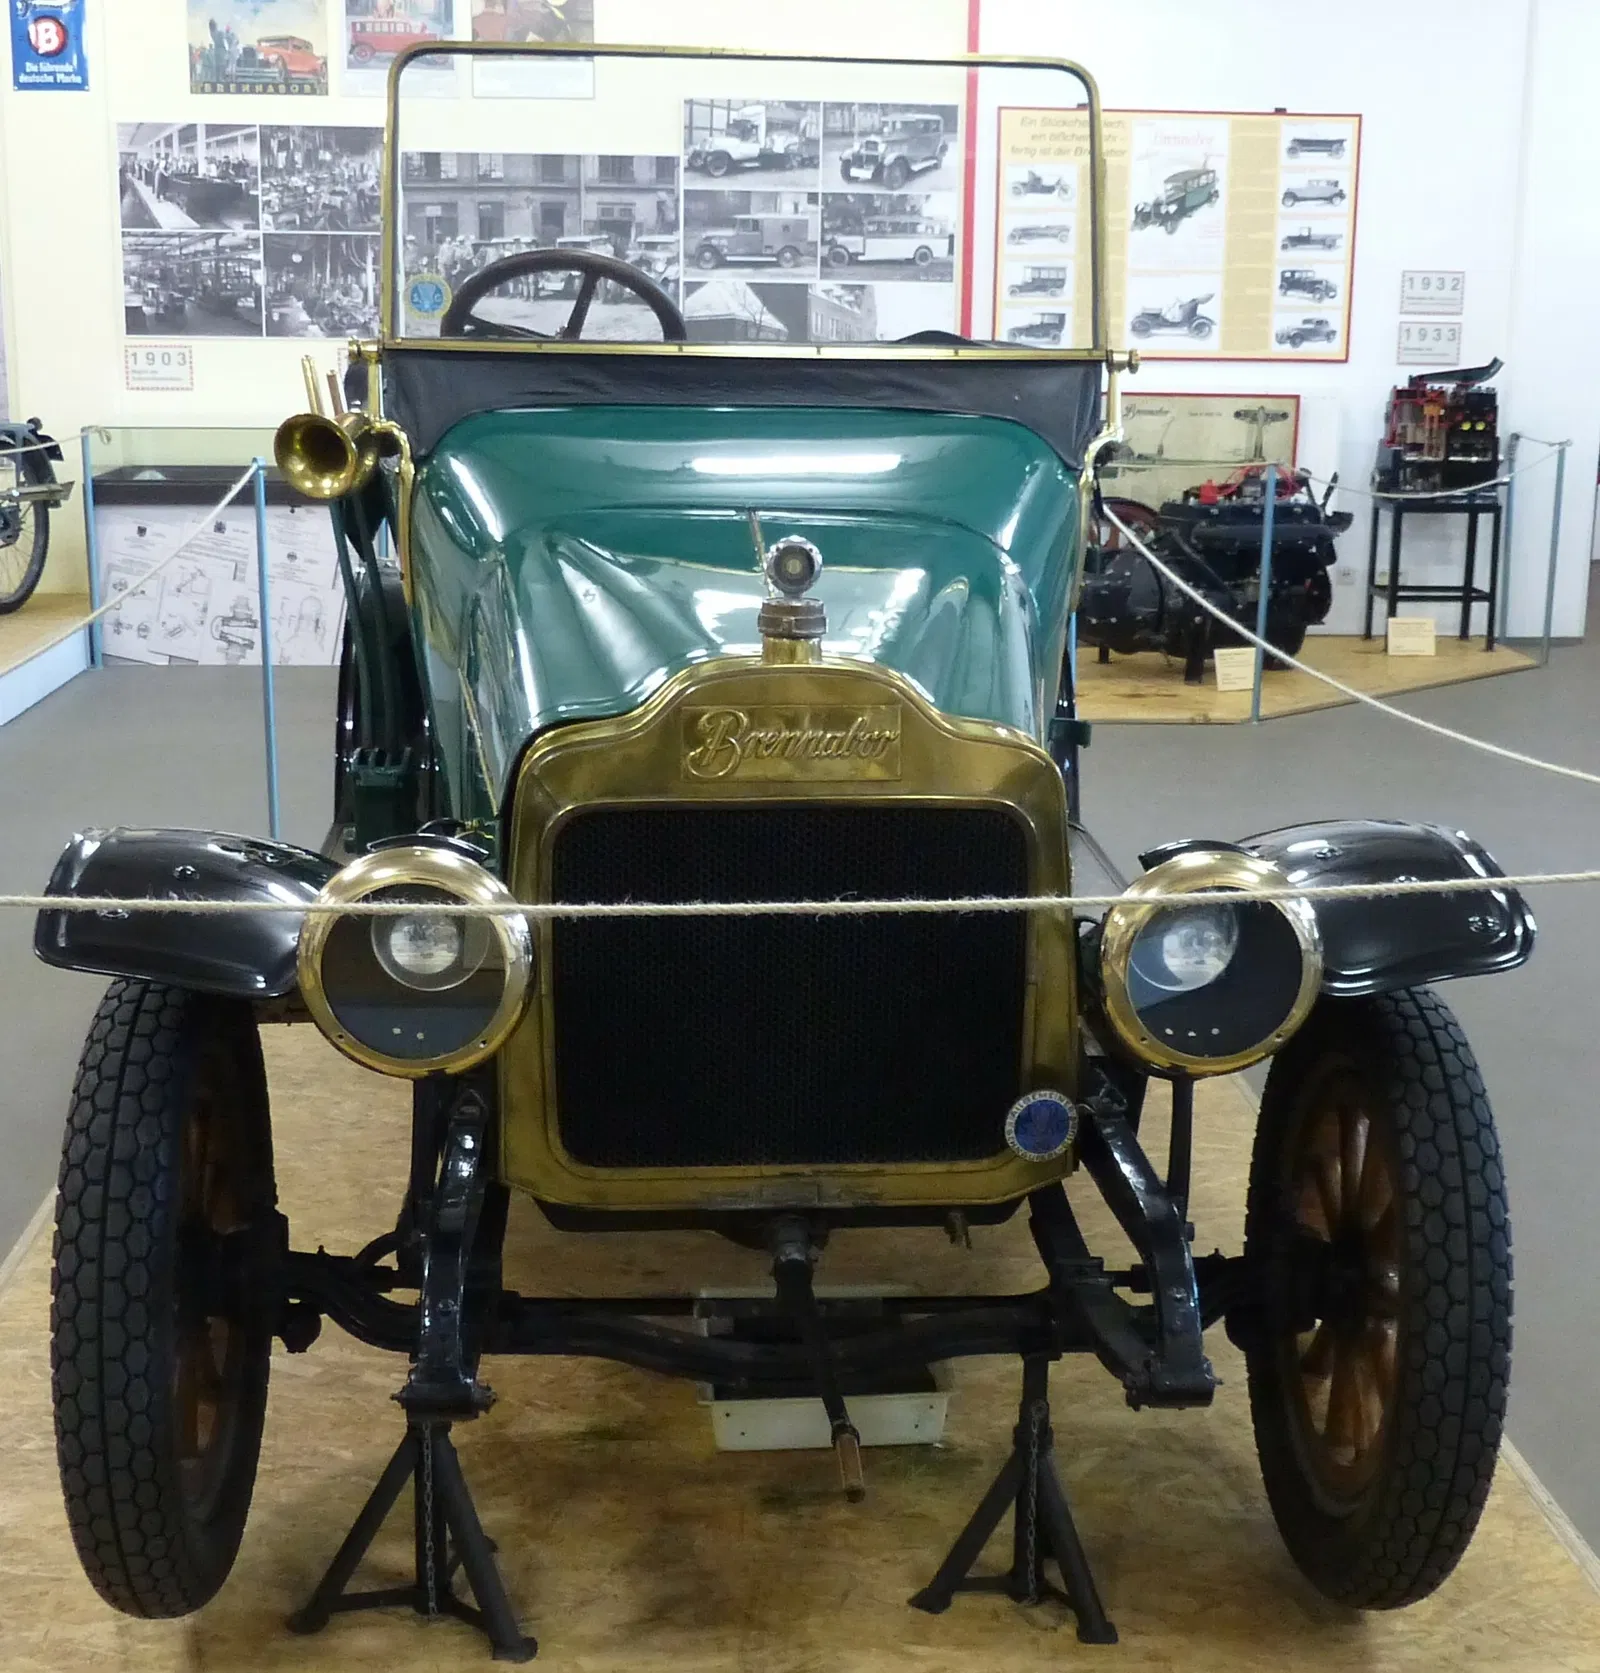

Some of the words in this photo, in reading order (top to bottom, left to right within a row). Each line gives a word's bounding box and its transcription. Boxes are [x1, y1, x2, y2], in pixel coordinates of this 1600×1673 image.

[1406, 276, 1461, 291] 1932
[1403, 327, 1457, 342] 1933
[131, 351, 187, 366] 1903
[687, 708, 900, 778] Brennabor
